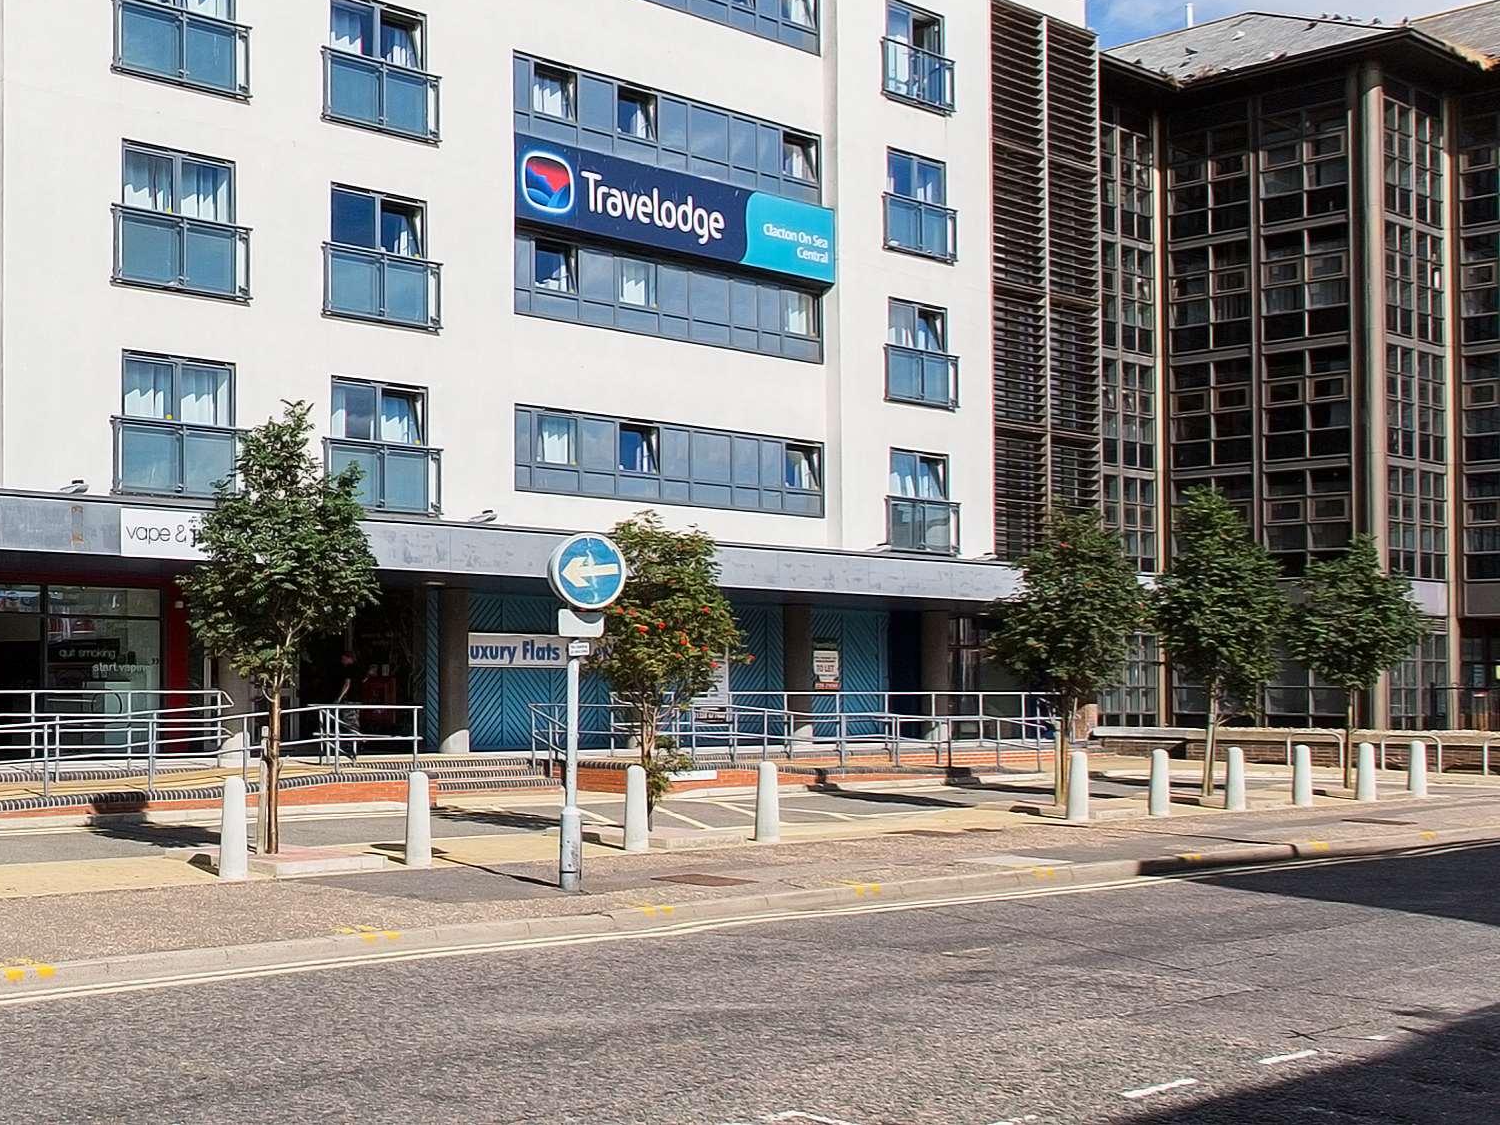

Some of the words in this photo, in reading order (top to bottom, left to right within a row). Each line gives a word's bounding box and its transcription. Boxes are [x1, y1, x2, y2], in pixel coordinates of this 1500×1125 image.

[581, 170, 725, 245] Travelodge
[762, 223, 797, 242] Clacton
[798, 231, 812, 244] On
[812, 235, 828, 249] Sea
[796, 246, 828, 264] Central
[125, 525, 171, 544] vape
[175, 524, 187, 543] &
[59, 649, 76, 660] quit
[78, 649, 116, 660] smoking
[469, 644, 517, 664] uxury
[522, 640, 561, 661] Flats
[92, 663, 117, 672] start
